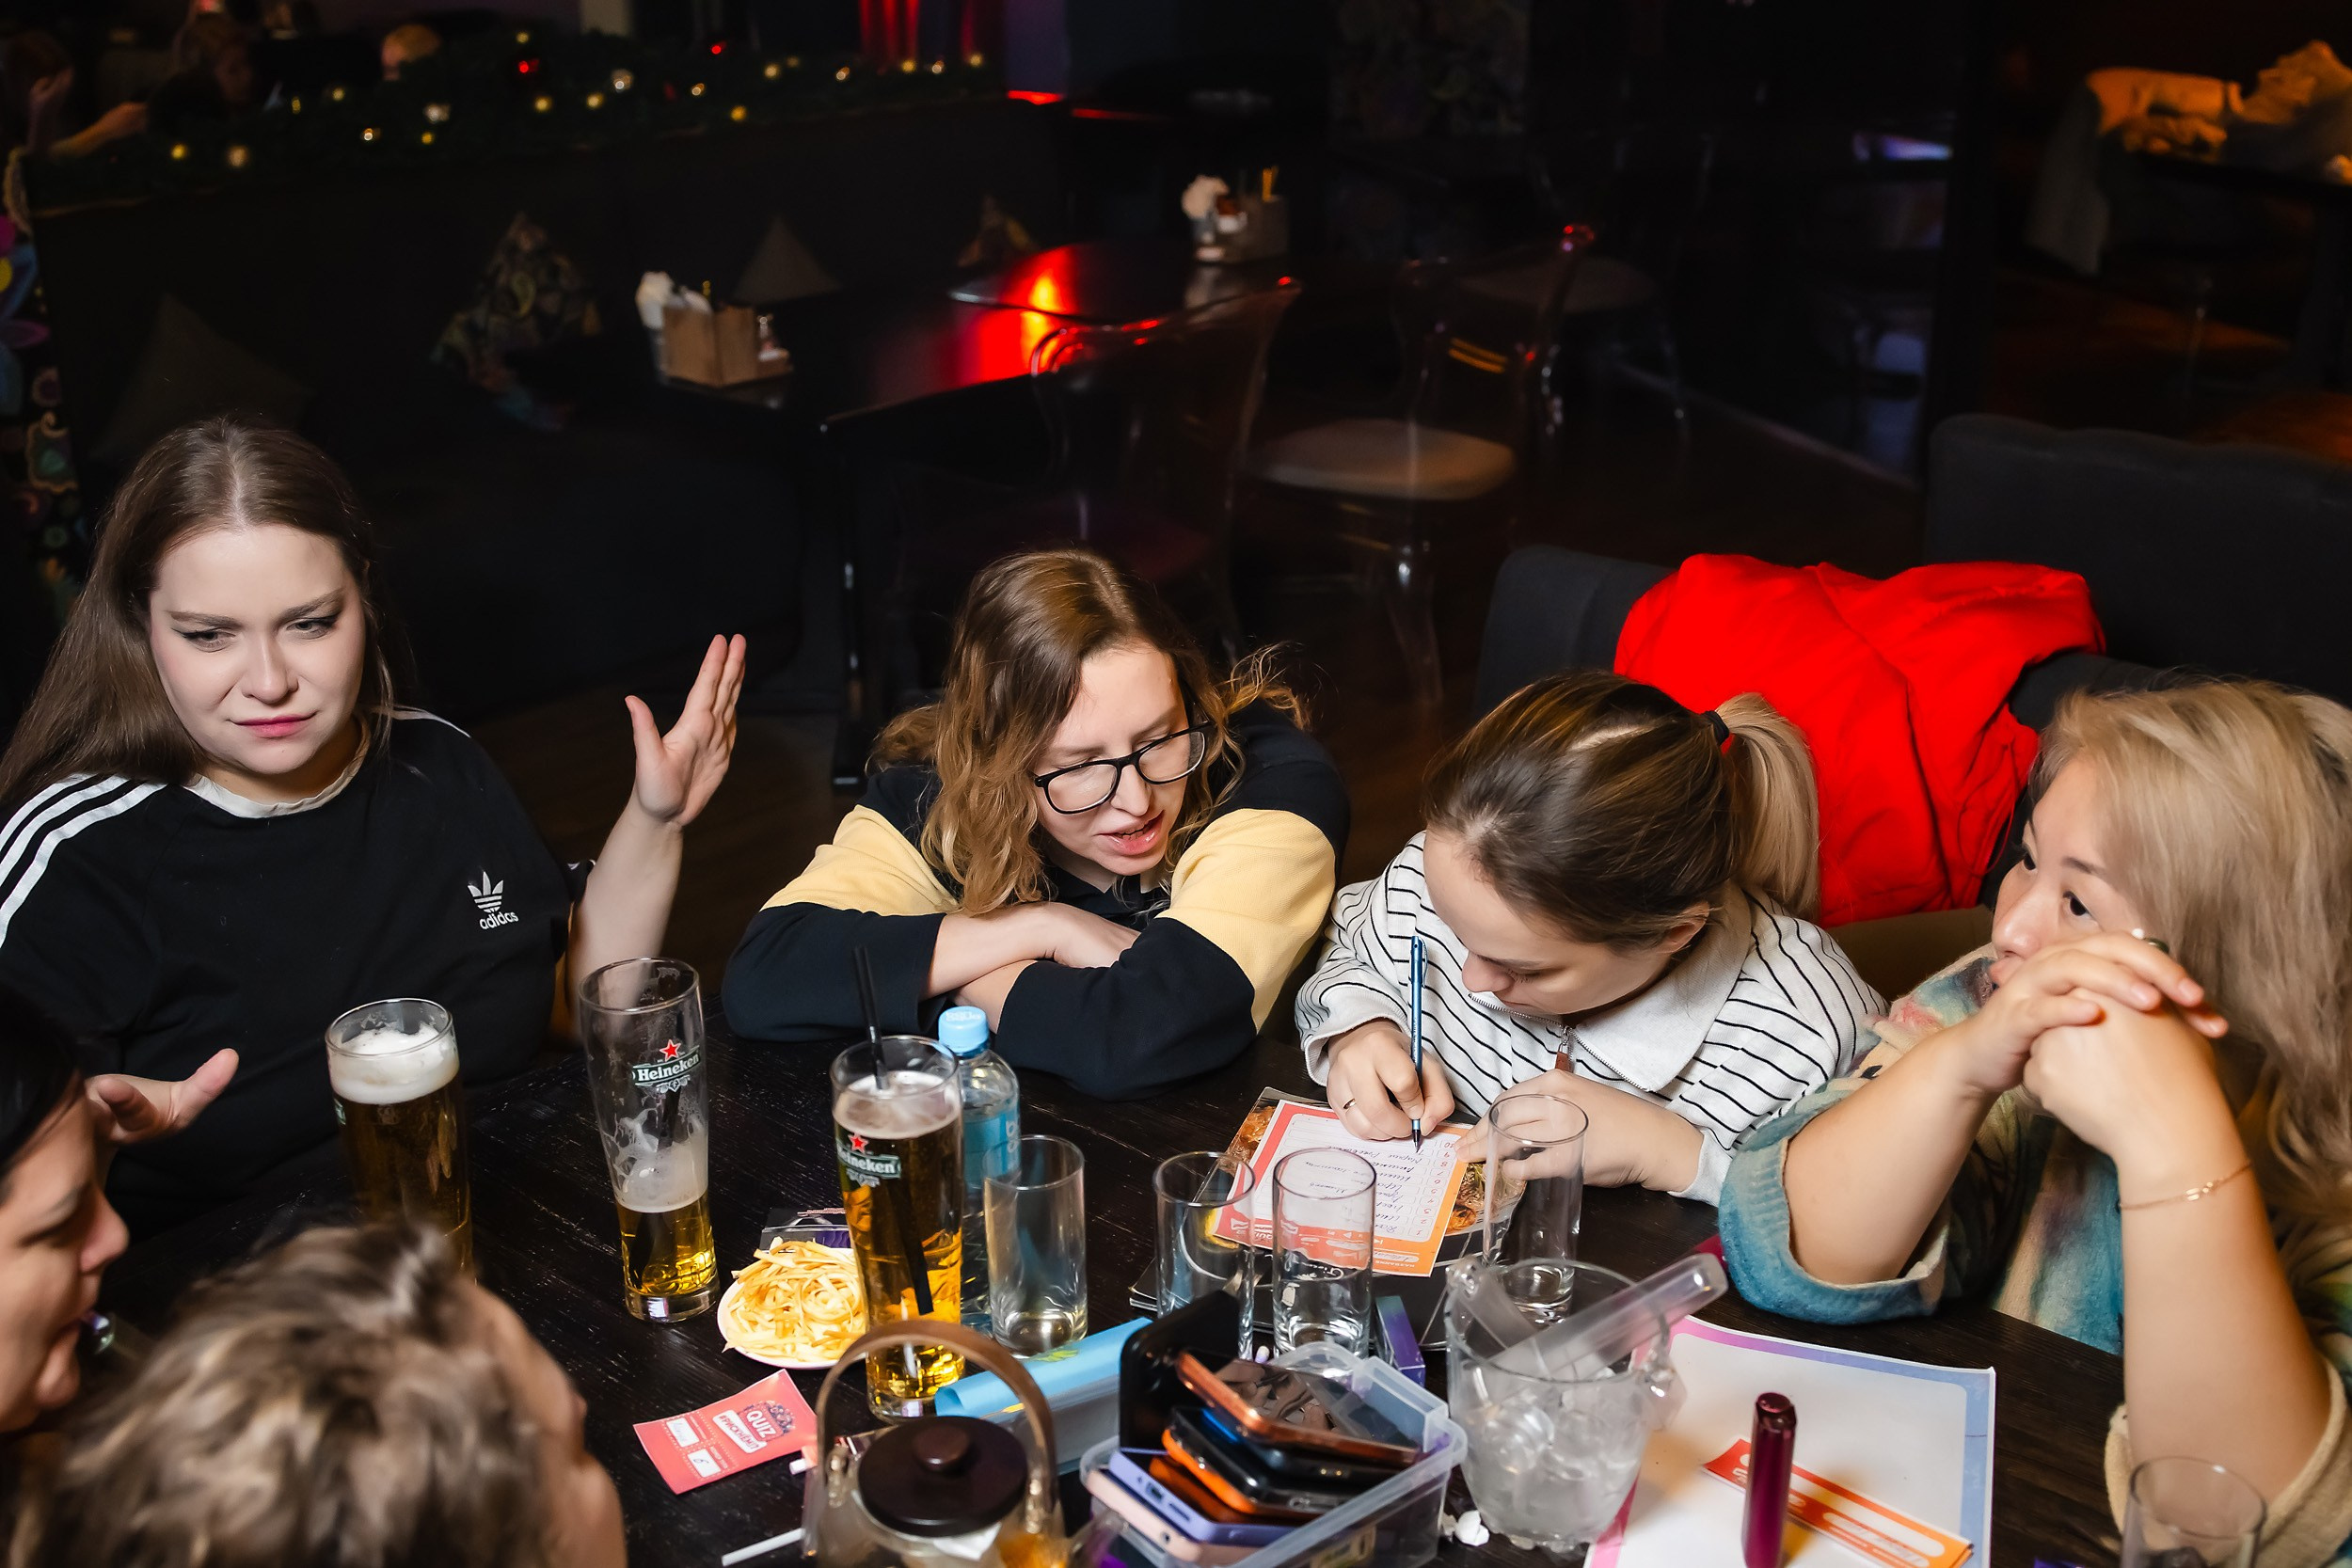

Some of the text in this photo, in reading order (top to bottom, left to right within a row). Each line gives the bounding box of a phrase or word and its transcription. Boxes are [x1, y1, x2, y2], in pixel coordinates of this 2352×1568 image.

[479, 911, 519, 930] adidas
[637, 1053, 700, 1082] Heineken
[746, 1410, 776, 1438] QUIZ
